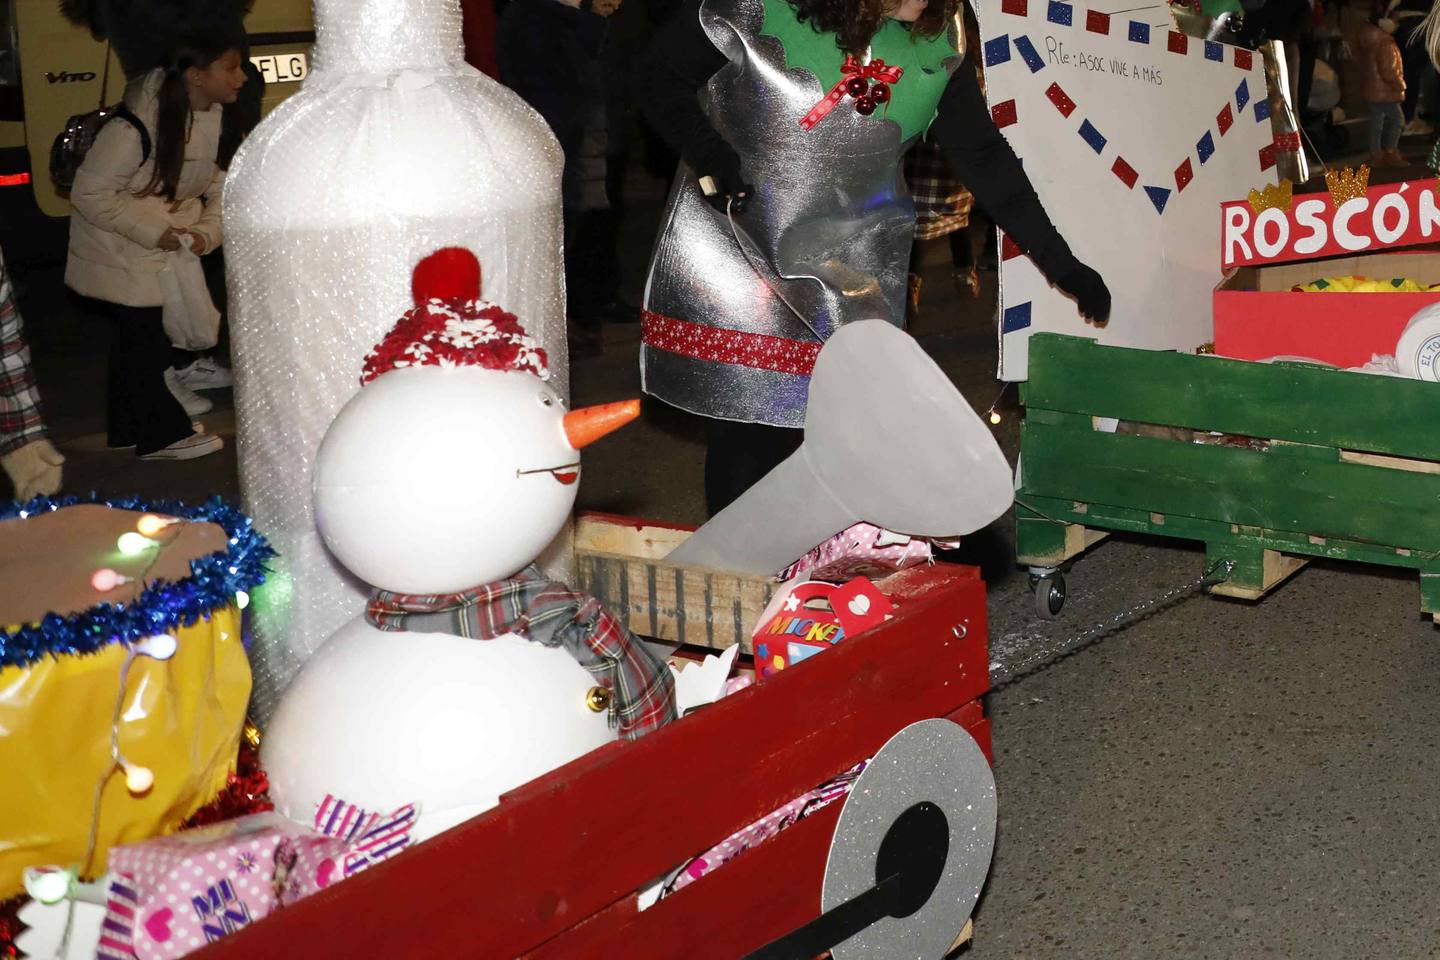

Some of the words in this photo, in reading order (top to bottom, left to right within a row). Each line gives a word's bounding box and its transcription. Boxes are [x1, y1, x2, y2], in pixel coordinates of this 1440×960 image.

[1110, 59, 1129, 77] VIVE
[1132, 65, 1140, 80] A
[1421, 354, 1432, 366] EL
[765, 616, 846, 645] MICKEY
[191, 878, 237, 920] MI
